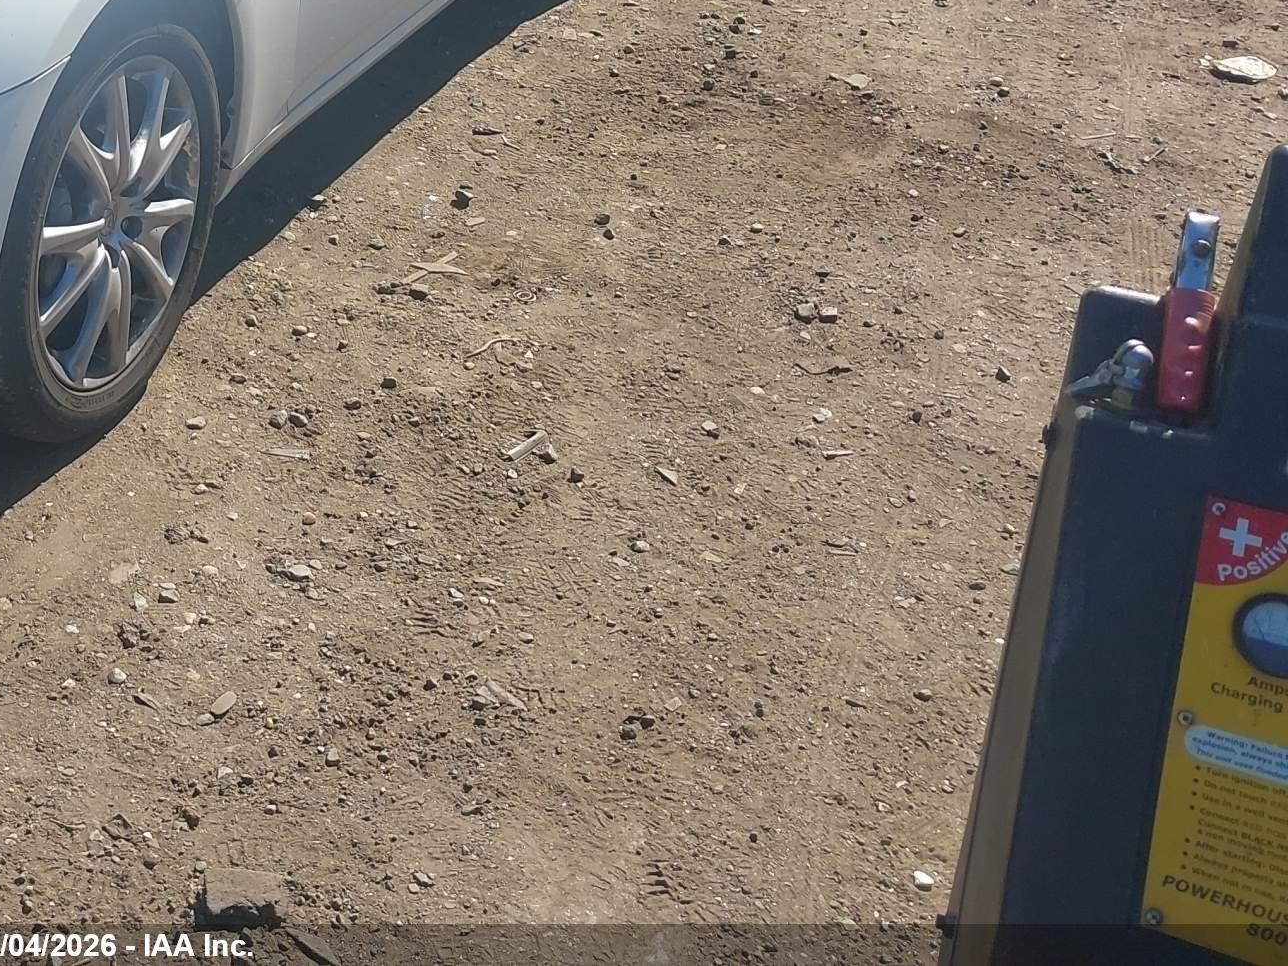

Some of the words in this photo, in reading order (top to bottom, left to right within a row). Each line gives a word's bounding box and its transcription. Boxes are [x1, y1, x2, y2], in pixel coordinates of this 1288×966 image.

[1216, 531, 1288, 581] Positive
[1210, 681, 1283, 714] Charging
[1202, 793, 1219, 804] Use
[1240, 831, 1274, 847] BLACK
[1244, 922, 1288, 946] 800
